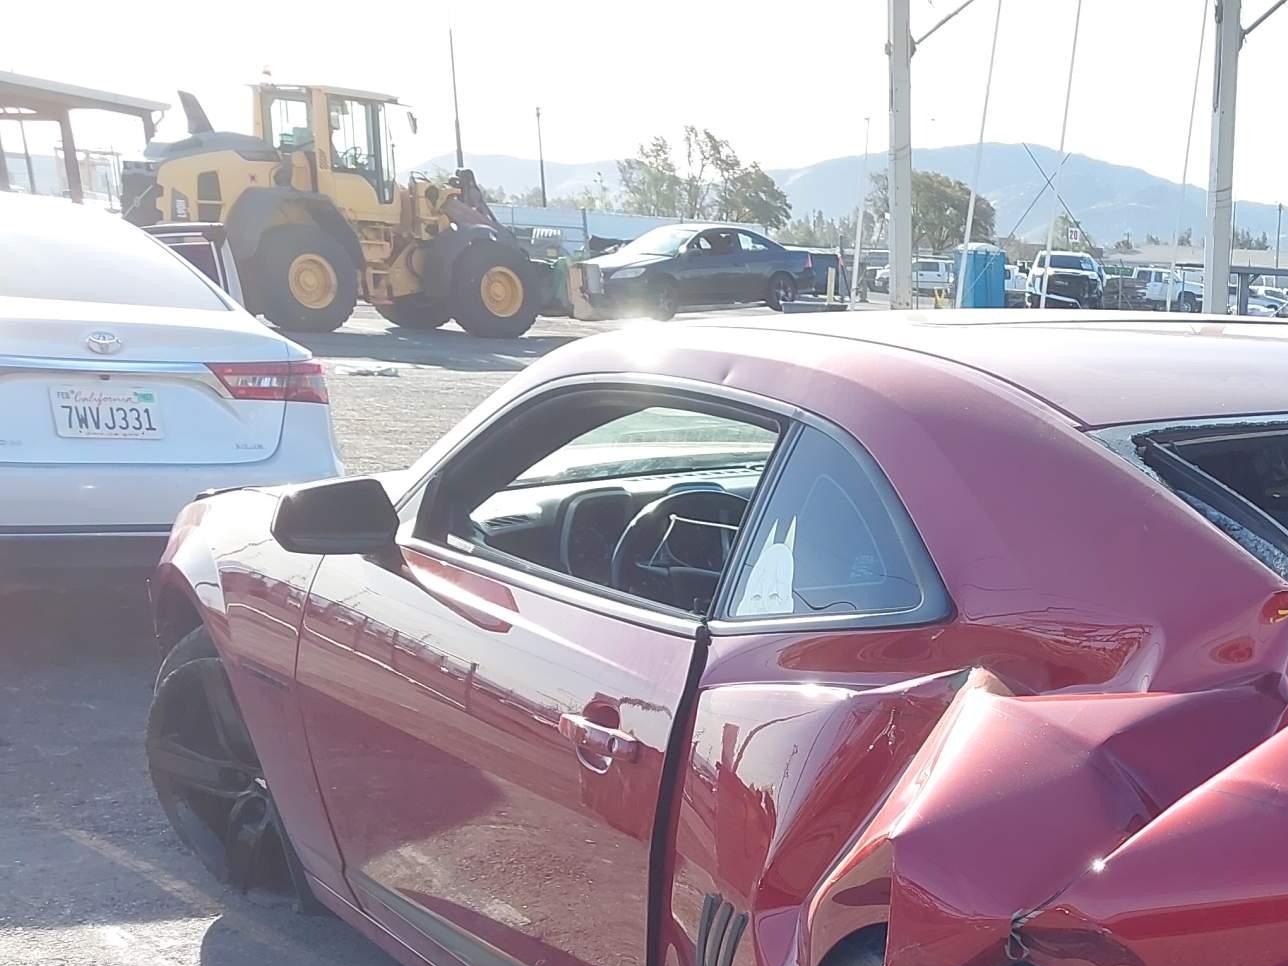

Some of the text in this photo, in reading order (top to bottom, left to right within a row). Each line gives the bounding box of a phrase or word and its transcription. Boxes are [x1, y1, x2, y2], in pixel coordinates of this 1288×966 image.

[1070, 230, 1078, 241] 20
[74, 391, 138, 406] California
[61, 405, 157, 431] 7WVJ331
